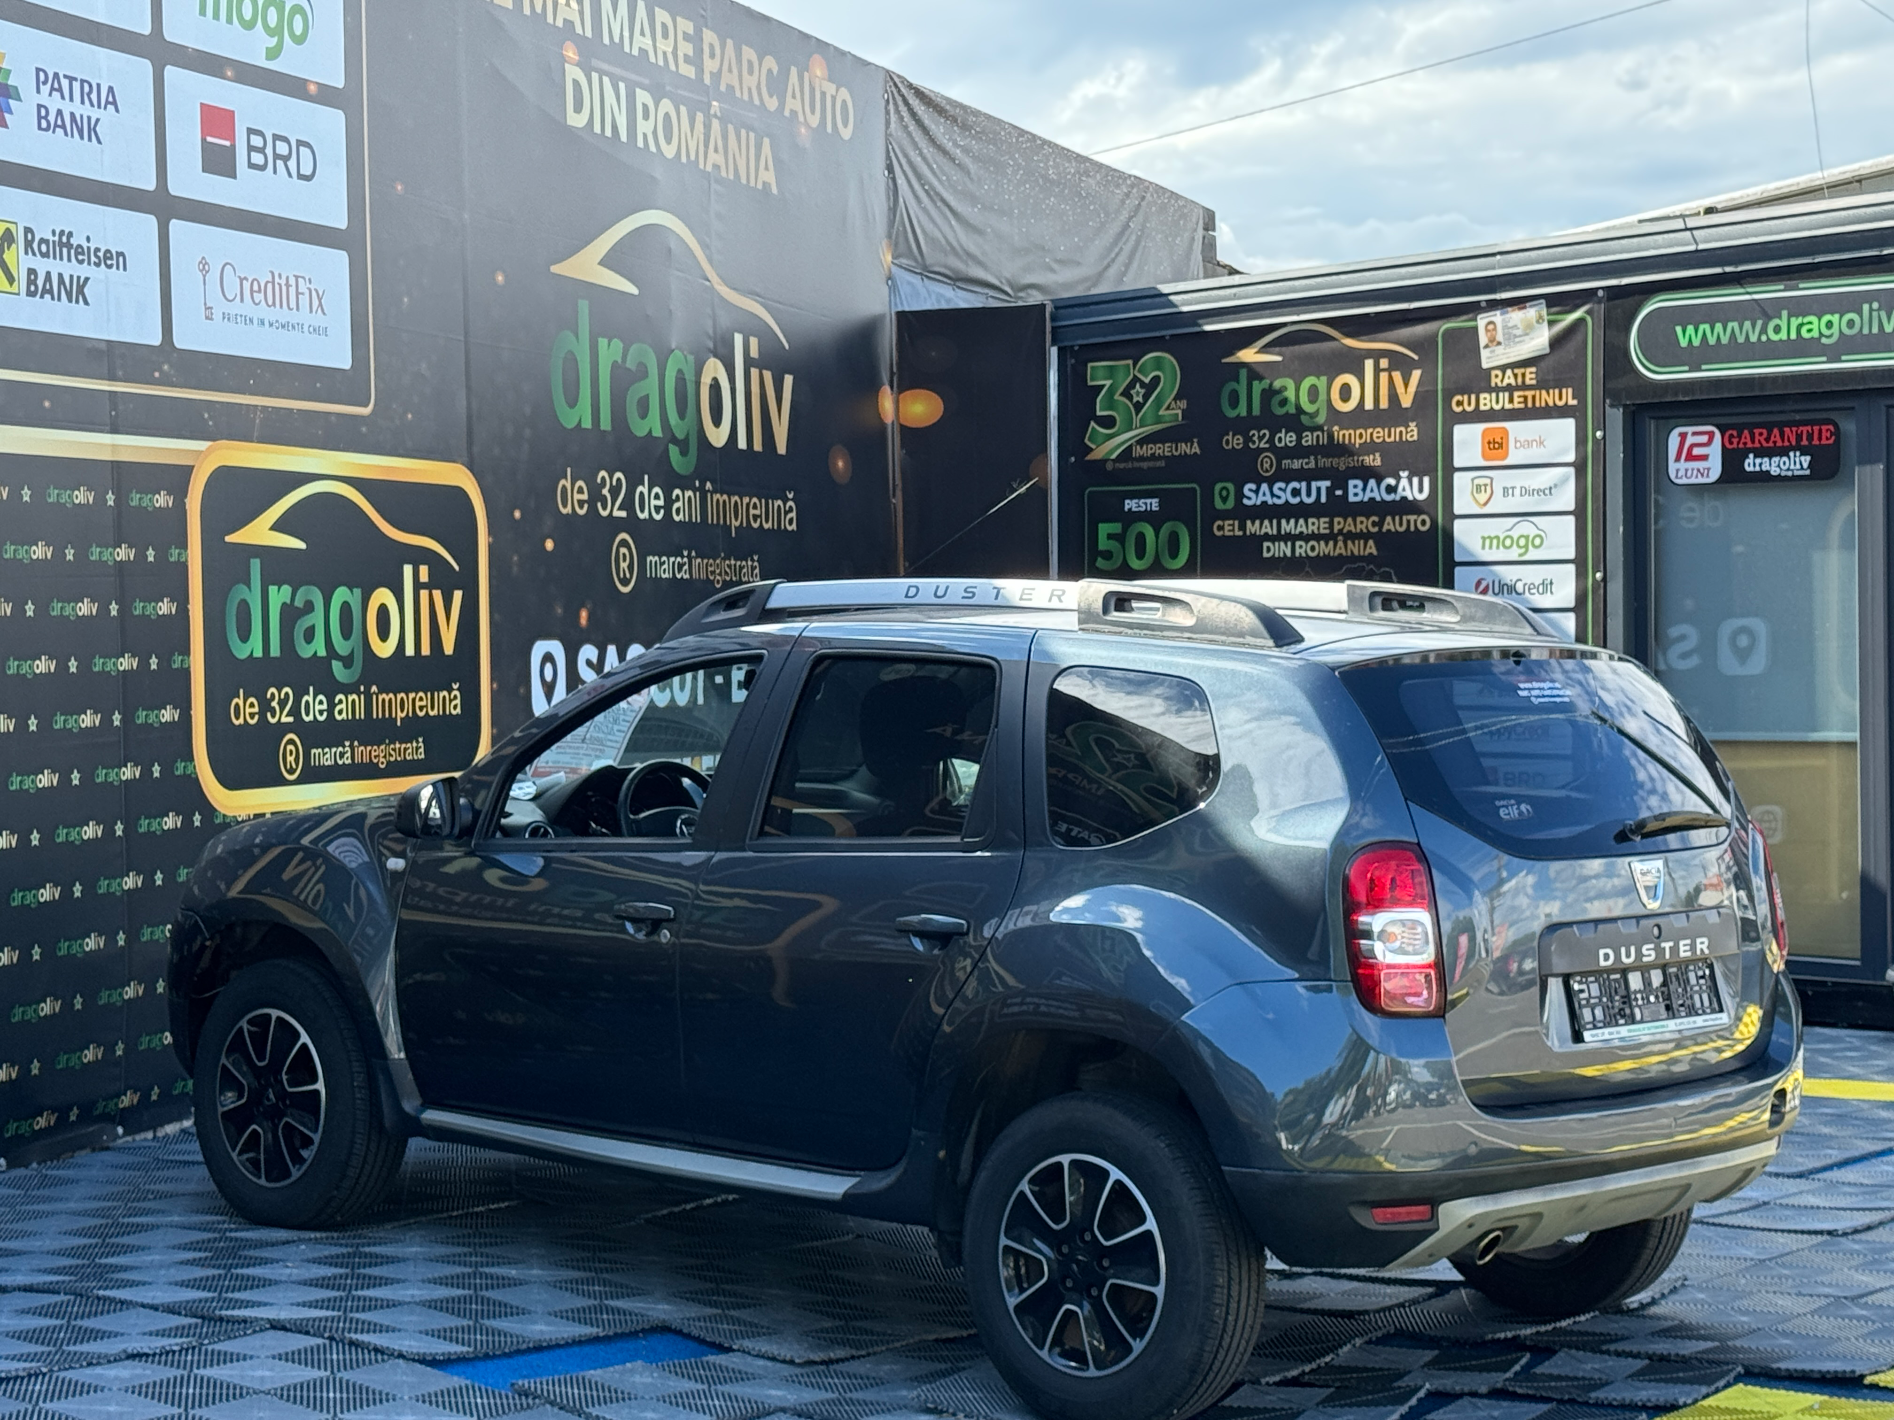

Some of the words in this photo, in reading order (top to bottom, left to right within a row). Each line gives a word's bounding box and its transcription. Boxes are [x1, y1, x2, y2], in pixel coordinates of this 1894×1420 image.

[601, 0, 696, 79] MARE
[702, 27, 779, 112] PARC
[783, 66, 854, 141] AUTO
[34, 66, 120, 114] PATRIA
[36, 103, 103, 145] BANK
[564, 62, 628, 144] DIN
[636, 103, 778, 195] ROMÂNIA
[246, 126, 318, 182] BRD
[23, 225, 128, 272] Raiffeisen
[25, 267, 90, 306] BANK
[219, 261, 327, 316] CreditFix
[308, 324, 329, 337] CHEIE
[1675, 301, 1894, 348] www.dragoliv
[552, 299, 794, 476] dragoliv
[1221, 358, 1423, 426] dragoliv
[1490, 367, 1537, 388] RATE
[1084, 352, 1181, 450] 32
[1451, 394, 1476, 413] CU
[1479, 387, 1578, 411] BULETINUL
[1222, 430, 1243, 450] de
[1249, 429, 1270, 448] 32
[1275, 428, 1297, 448] de
[1301, 426, 1327, 446] ani
[1332, 422, 1419, 449] împreună
[1486, 436, 1504, 451] tbi
[1514, 435, 1546, 450] bank
[1674, 431, 1715, 463] 12
[1723, 424, 1836, 449] GARANTIE
[1282, 455, 1315, 470] marcă
[1317, 453, 1382, 471] înregistrată
[1674, 467, 1711, 480] LUNI
[1744, 450, 1812, 476] dragoliv
[46, 485, 95, 507] dragoliv
[129, 490, 174, 511] dragoliv
[557, 467, 589, 516] de
[597, 469, 628, 518] 32
[635, 474, 665, 521] de
[672, 480, 701, 523] ani
[706, 481, 798, 537] împreună
[1242, 480, 1332, 506] SASCUT
[1348, 471, 1431, 503] BACĂU
[1475, 483, 1489, 494] BT
[1502, 486, 1517, 498] BT
[1124, 498, 1160, 512] PESTE
[1213, 519, 1243, 536] CEL
[1246, 518, 1278, 536] MAI
[1281, 518, 1330, 535] MARE
[1333, 516, 1380, 534] PARC
[1382, 514, 1431, 532] AUTO
[3, 541, 53, 564] dragoliv
[89, 543, 135, 565] dragoliv
[1095, 521, 1191, 571] 500
[1262, 541, 1291, 558] DIN
[1294, 536, 1378, 558] ROMÂNIA
[1481, 533, 1545, 558] mogo
[646, 549, 690, 579] marcă
[691, 550, 761, 588] înregistrată
[904, 585, 1067, 604] DUSTER
[1492, 578, 1554, 596] UniCredit
[50, 597, 98, 620] dragoliv
[132, 597, 177, 620] dragoliv
[225, 558, 463, 684] dragoliv
[5, 655, 56, 678] dragoliv
[92, 653, 139, 676] dragoliv
[53, 709, 101, 732] dragoliv
[135, 705, 180, 727] dragoliv
[230, 689, 259, 726] de
[266, 687, 295, 724] 32
[301, 686, 328, 722] de
[334, 686, 365, 721] ani
[371, 683, 461, 726] împreună
[311, 742, 352, 767] marcă
[354, 737, 425, 769] înregistrată
[8, 769, 59, 793] dragoliv
[95, 762, 141, 785] dragoliv
[55, 821, 104, 844] dragoliv
[137, 812, 182, 835] dragoliv
[10, 883, 61, 908] dragoliv
[97, 871, 143, 895] dragoliv
[56, 932, 105, 957] dragoliv
[1598, 937, 1710, 967] DUSTER
[11, 997, 61, 1023] dragoliv
[98, 980, 144, 1006] dragoliv
[55, 1043, 104, 1070] dragoliv
[4, 1110, 58, 1137] dragoliv
[93, 1090, 140, 1115] dragoliv
